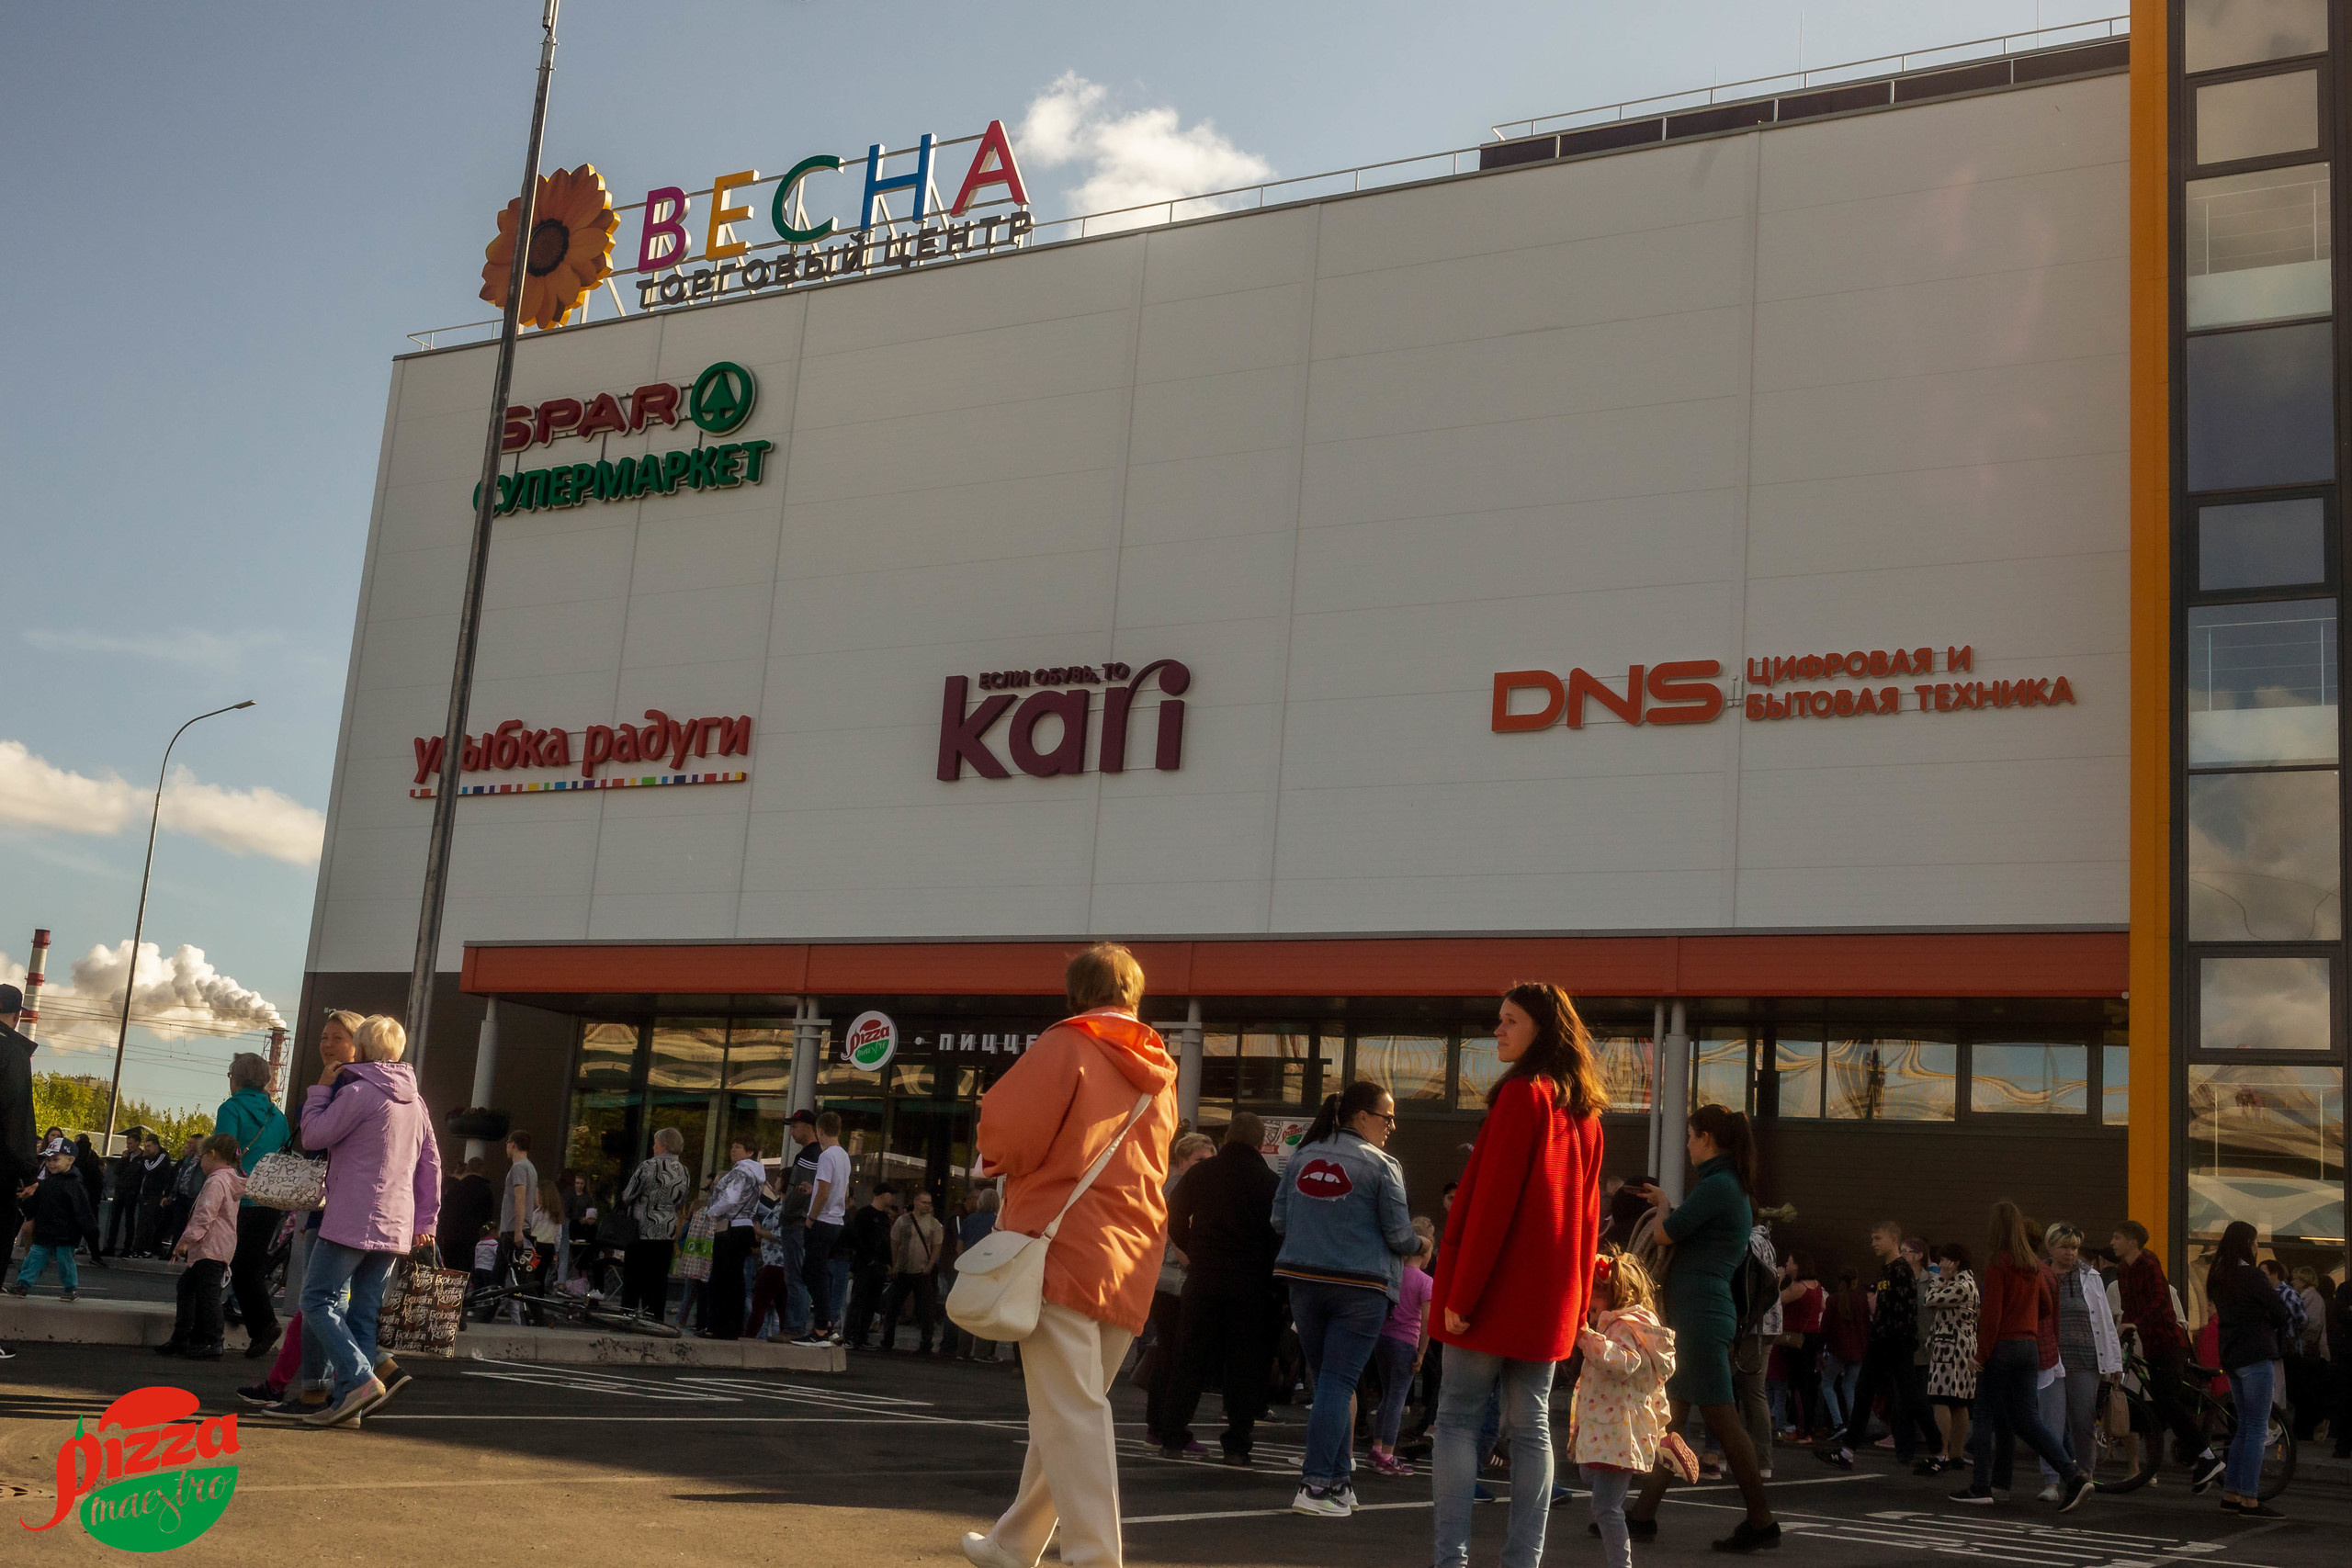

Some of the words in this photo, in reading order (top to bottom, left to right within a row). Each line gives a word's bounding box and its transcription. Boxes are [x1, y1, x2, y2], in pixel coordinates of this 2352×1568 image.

[638, 119, 1031, 273] ВЕСНА
[636, 230, 870, 310] ТОРГОВЫЙ
[884, 211, 1035, 268] ЦЕНТР
[502, 382, 682, 453] SPAR
[979, 671, 1031, 689] ЕСЛИ
[1034, 665, 1101, 685] ОБУВЬ,
[1102, 662, 1131, 681] ТО
[1491, 660, 1724, 732] DNS
[1747, 648, 1932, 687] ЦИФРОВАЯ
[1947, 645, 1973, 672] И
[1747, 686, 1901, 720] БЫТОВАЯ
[1915, 675, 2076, 713] ТЕХНИКА
[582, 709, 752, 778] радуги
[936, 659, 1191, 781] kari
[939, 1033, 1039, 1055] ПИЦЦЕ
